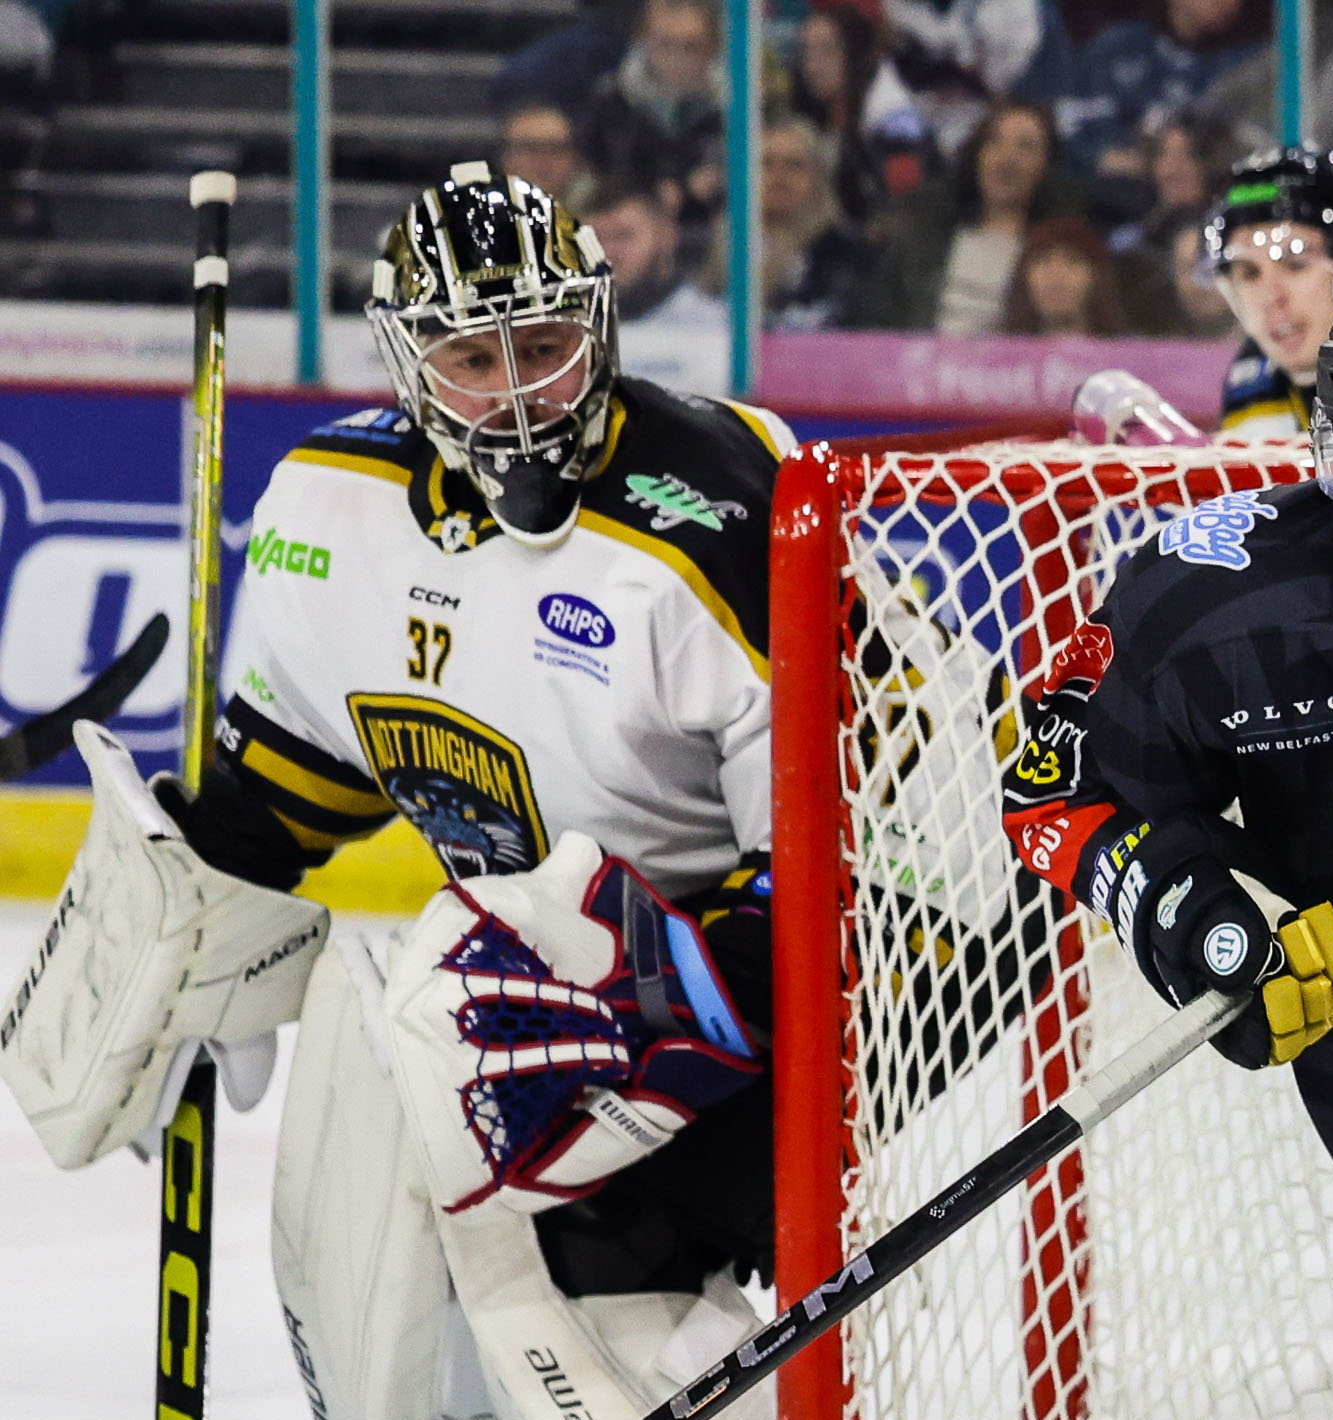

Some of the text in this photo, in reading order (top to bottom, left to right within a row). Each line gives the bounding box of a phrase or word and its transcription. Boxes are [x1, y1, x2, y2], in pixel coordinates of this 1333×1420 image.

[409, 586, 461, 610] CCM
[546, 598, 606, 644] RHPS
[406, 616, 452, 688] 37
[1236, 742, 1270, 755] NEW
[244, 925, 318, 983] MACH
